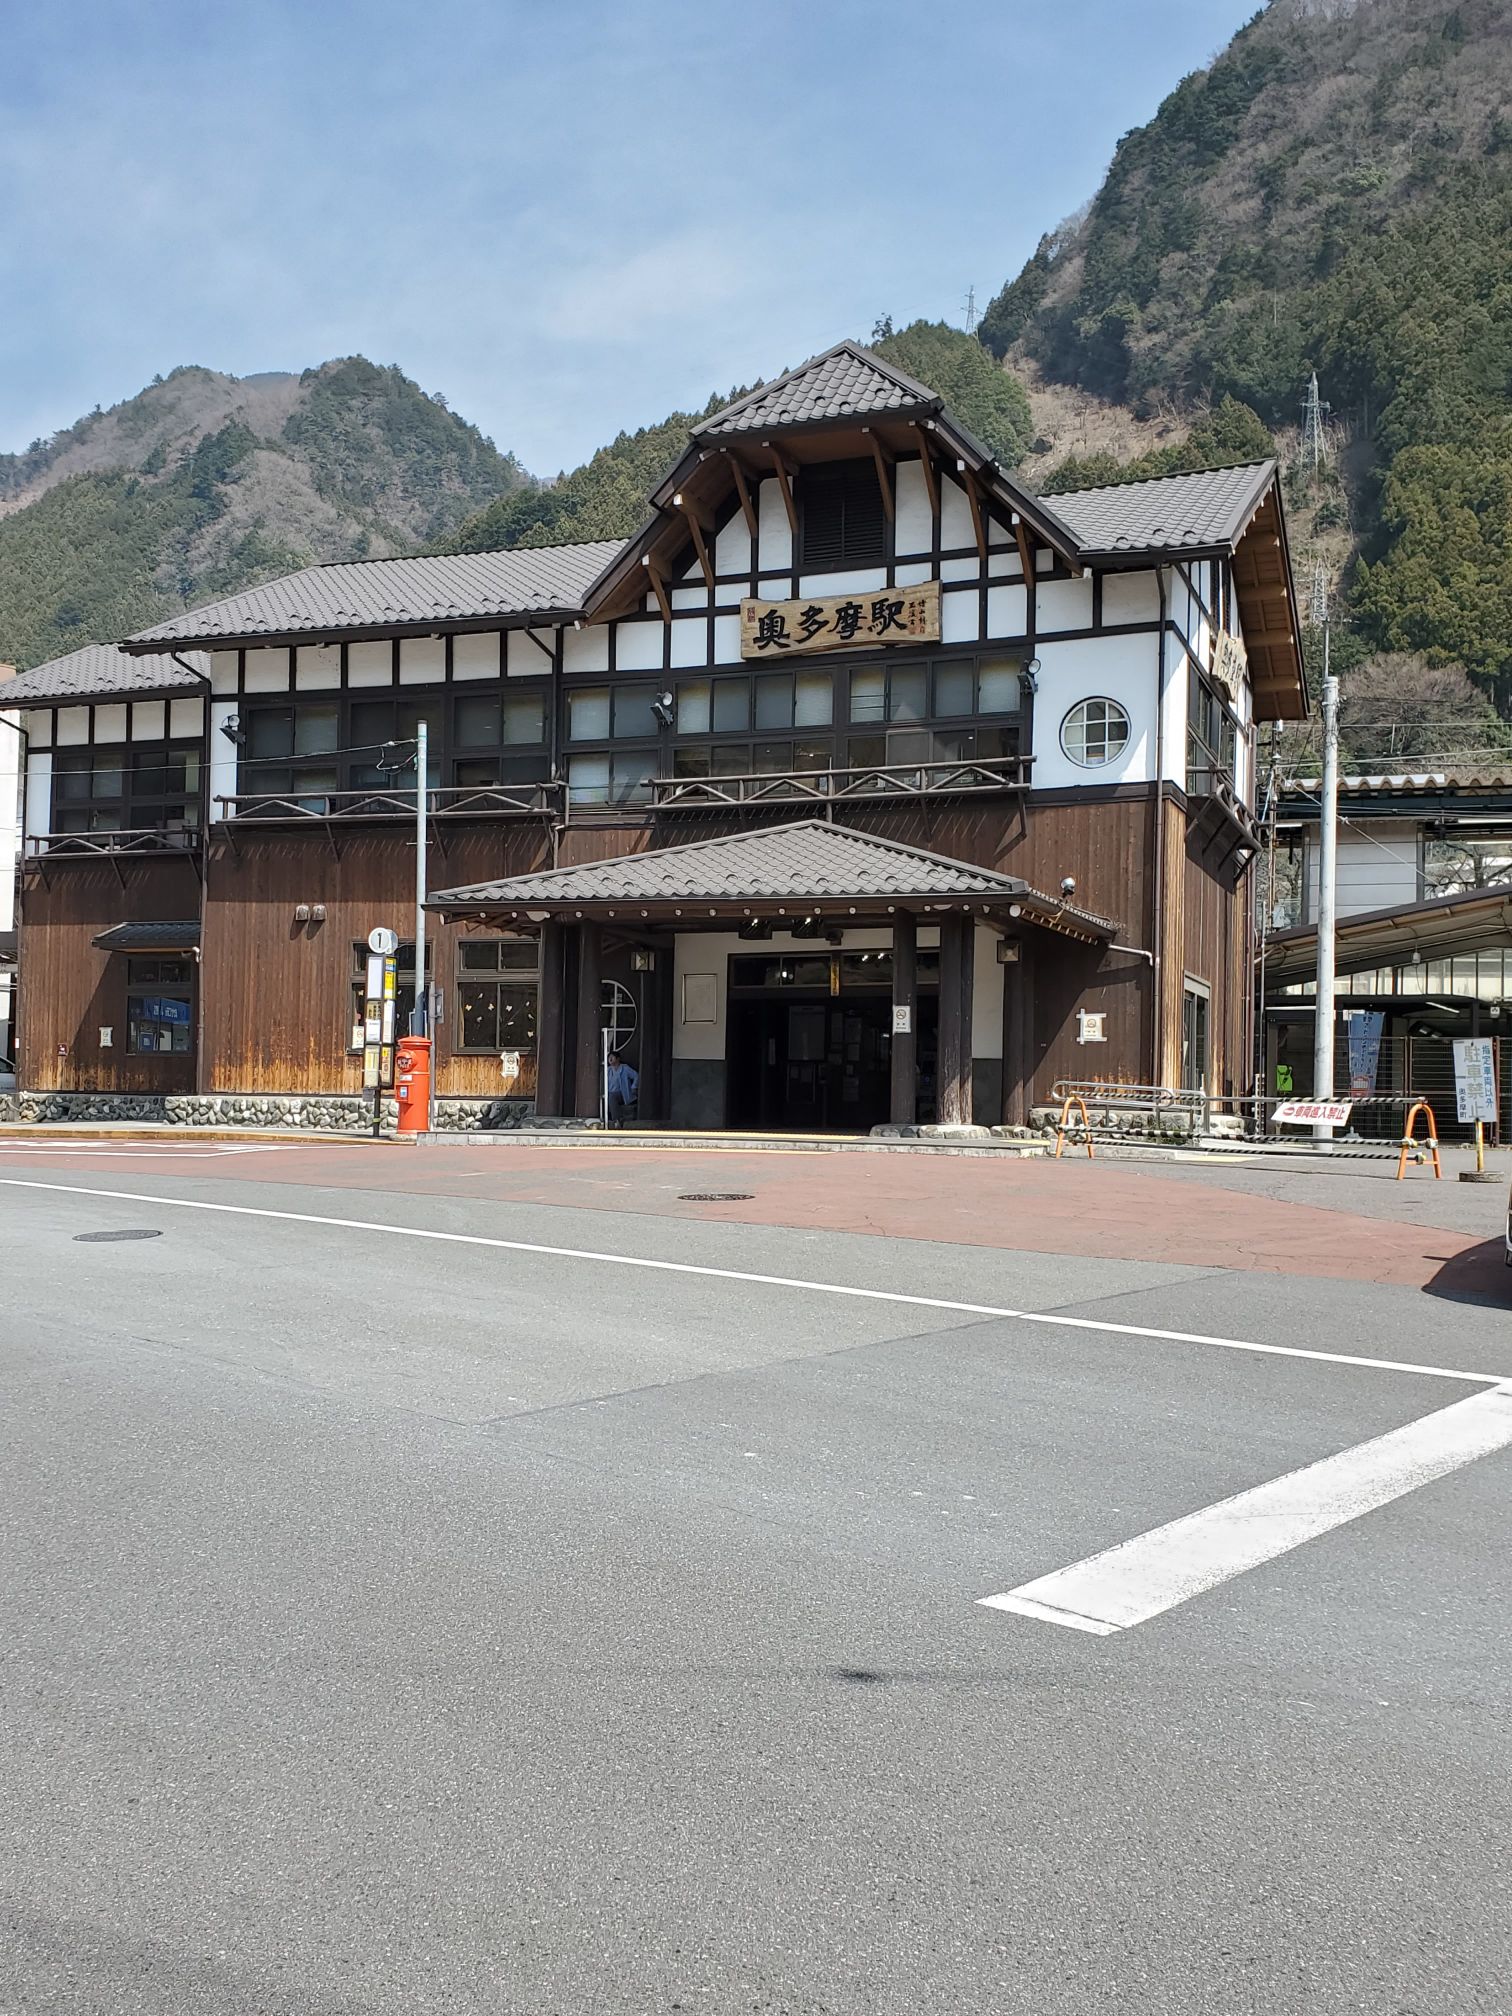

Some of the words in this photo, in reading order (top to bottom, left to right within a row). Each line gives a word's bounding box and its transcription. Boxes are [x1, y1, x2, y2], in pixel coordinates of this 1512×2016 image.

[753, 598, 907, 650] 奥多摩駅
[1464, 1046, 1485, 1118] 駐車禁止
[1482, 1045, 1493, 1108] 指定車両以外
[1294, 1105, 1345, 1121] 車両進入禁止
